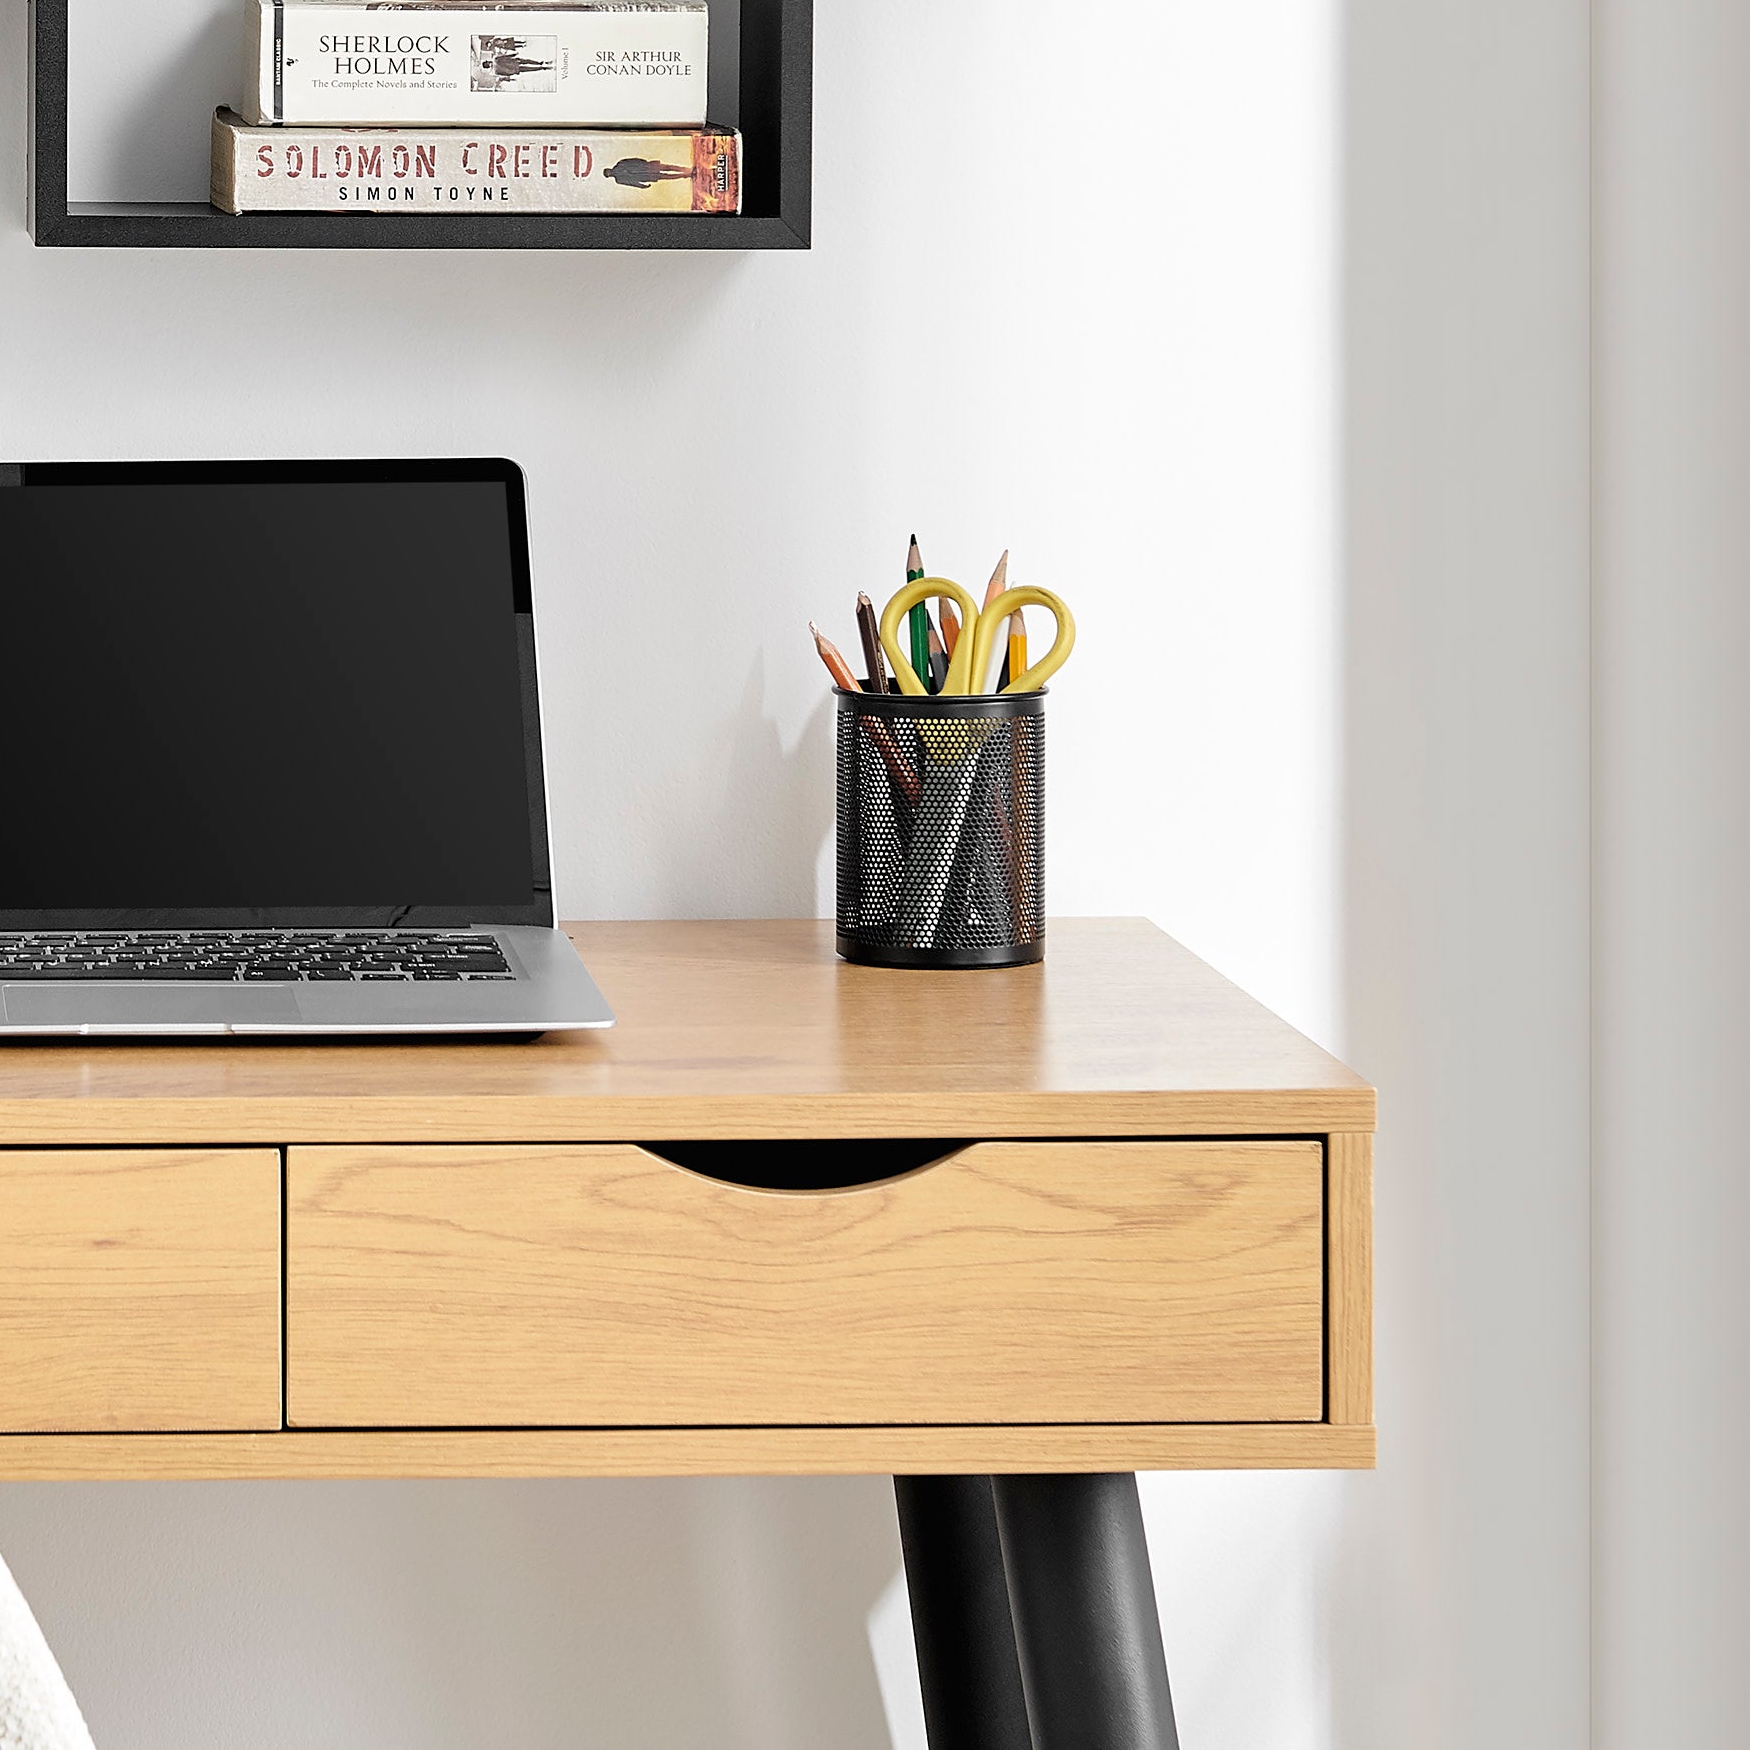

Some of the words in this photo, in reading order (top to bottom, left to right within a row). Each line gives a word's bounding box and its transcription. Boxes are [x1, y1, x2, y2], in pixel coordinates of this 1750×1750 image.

[319, 35, 449, 54] SHERLOCK
[595, 50, 616, 62] SIR
[621, 51, 682, 62] ARTHUR
[335, 57, 435, 76] HOLMES
[561, 52, 569, 80] Volume
[586, 64, 642, 76] CONAN
[646, 64, 692, 76] DOYLE
[311, 78, 329, 88] The
[330, 78, 374, 91] Complete
[376, 79, 407, 89] Novels
[409, 79, 425, 89] and
[426, 79, 458, 89] Stories
[256, 144, 437, 179] SOLOMON
[461, 142, 594, 179] CREED
[716, 153, 725, 193] HARPER
[338, 186, 414, 201] SIMON
[433, 186, 509, 201] TOYNE
